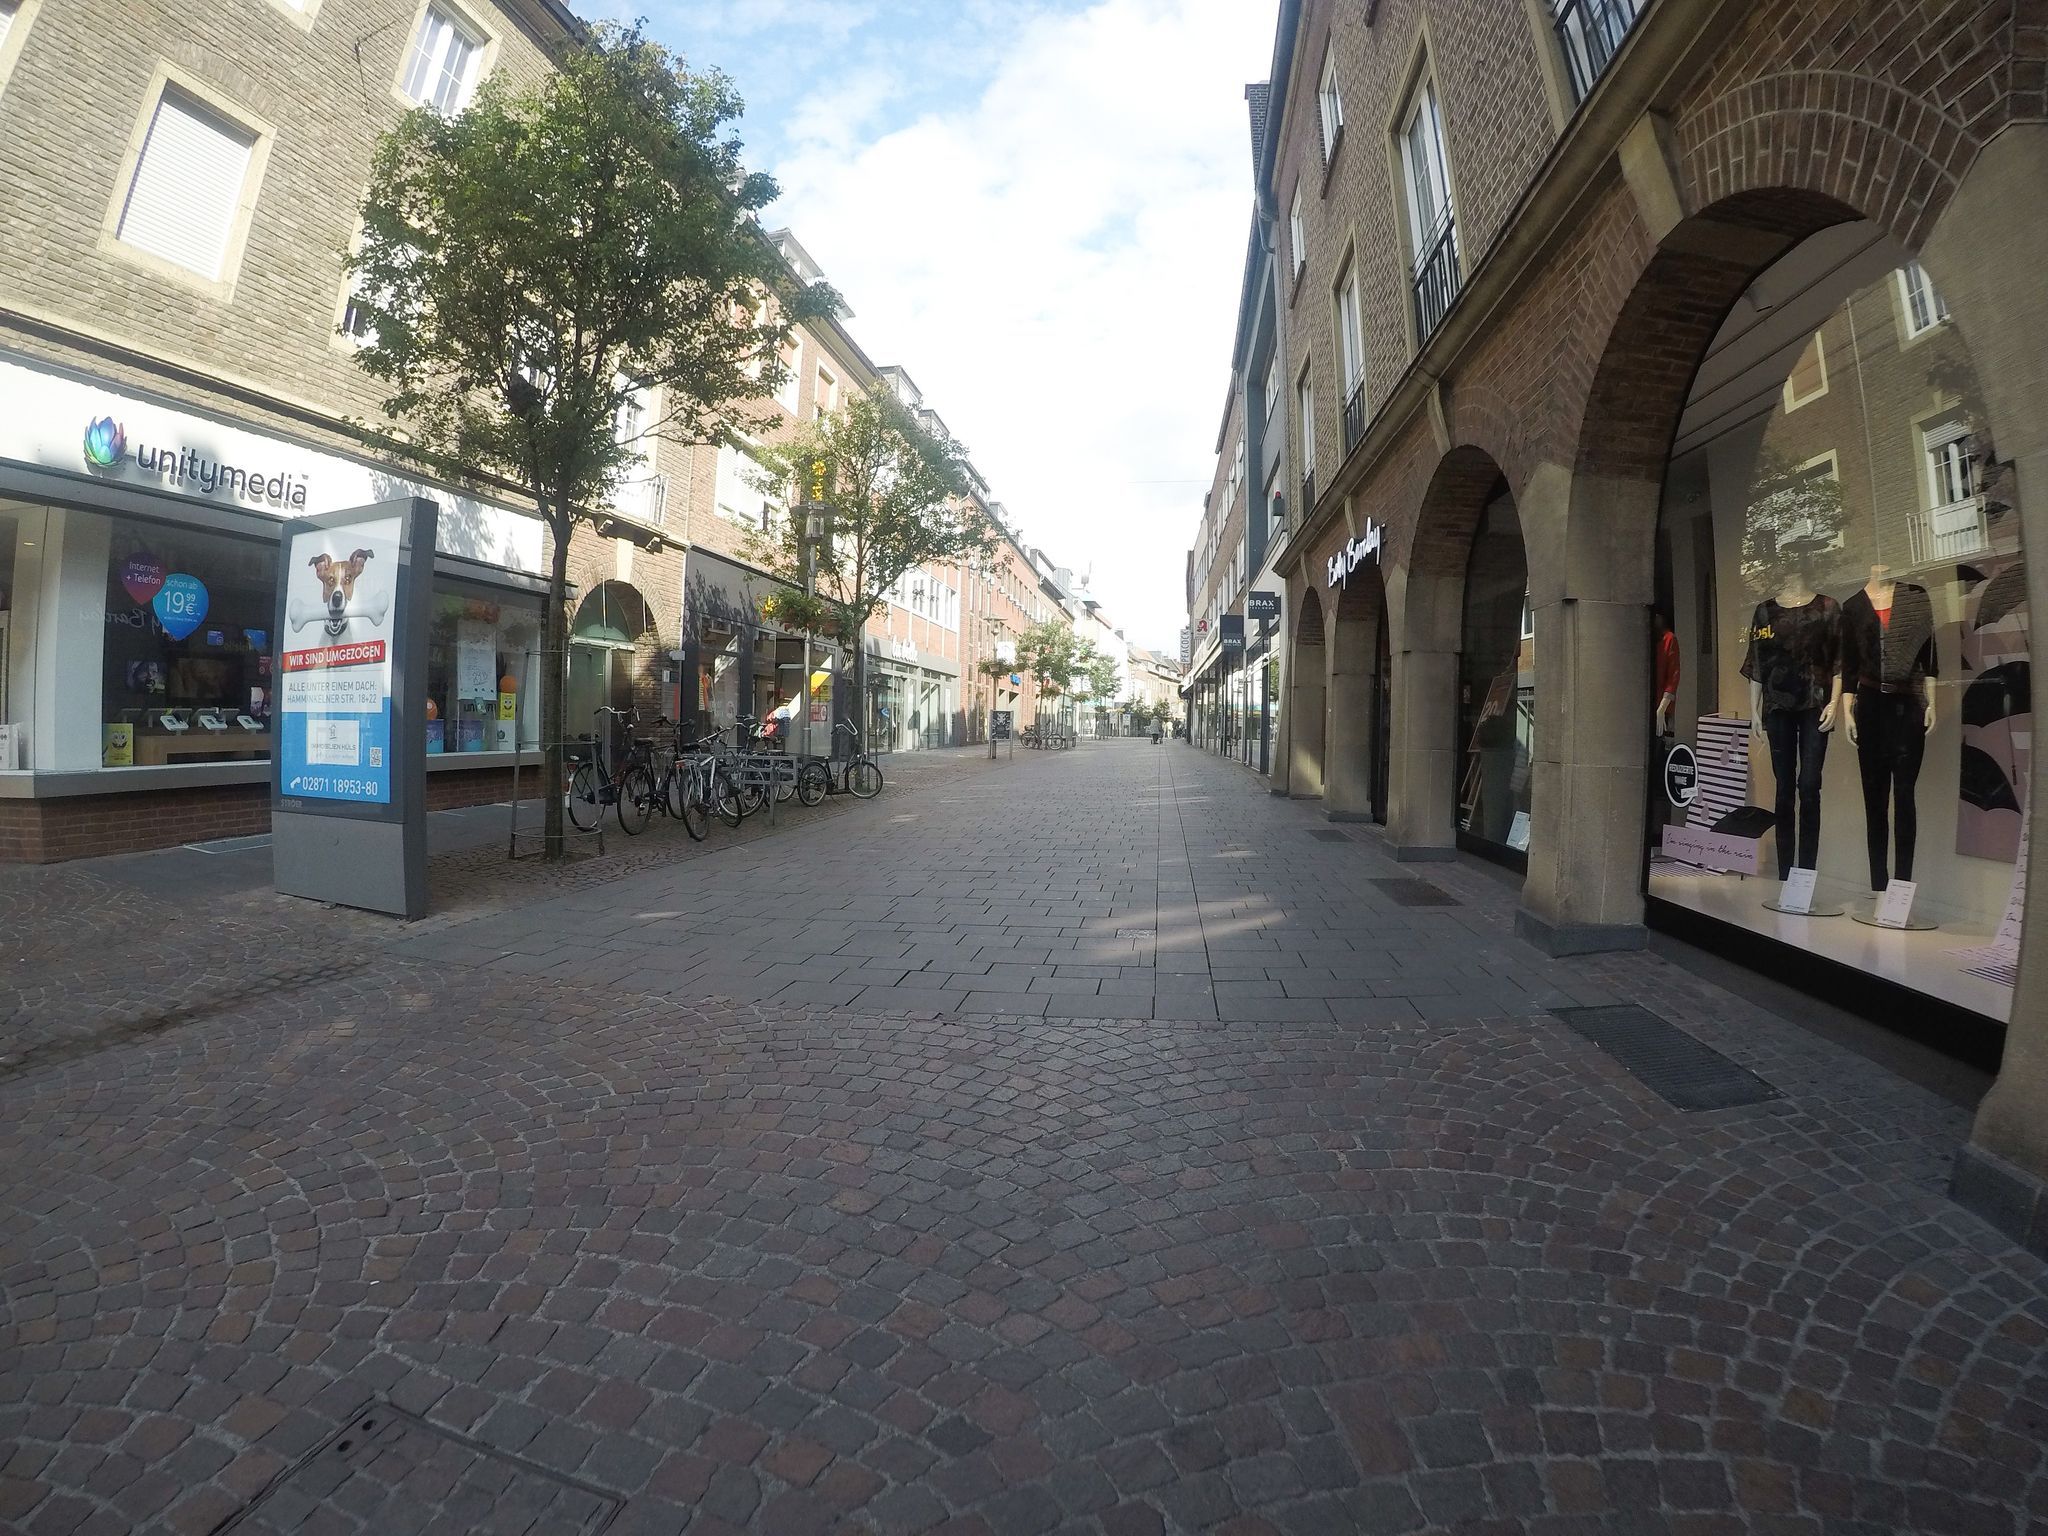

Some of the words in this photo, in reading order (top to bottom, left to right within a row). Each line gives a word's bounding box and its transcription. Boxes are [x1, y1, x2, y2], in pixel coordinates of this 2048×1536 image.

[137, 444, 307, 505] unitymedia
[129, 561, 160, 574] Internet
[133, 573, 161, 585] Telefon
[166, 579, 188, 589] schon
[187, 580, 198, 589] ab
[164, 591, 185, 614] 19
[1180, 630, 1190, 663] PEACOCK
[289, 654, 304, 666] WIR
[305, 652, 324, 665] SIND
[326, 644, 381, 662] UMGEZOGEN
[288, 681, 305, 692] ALLE
[306, 681, 330, 691] UNTER
[331, 681, 354, 691] EINEM
[355, 681, 377, 691] DACH:
[287, 694, 342, 704] HAMMINKELNER
[341, 694, 356, 704] STR.
[358, 694, 377, 704] 18+22
[302, 776, 329, 792] 02871
[332, 778, 378, 796] 18953-80
[1717, 844, 1732, 855] the
